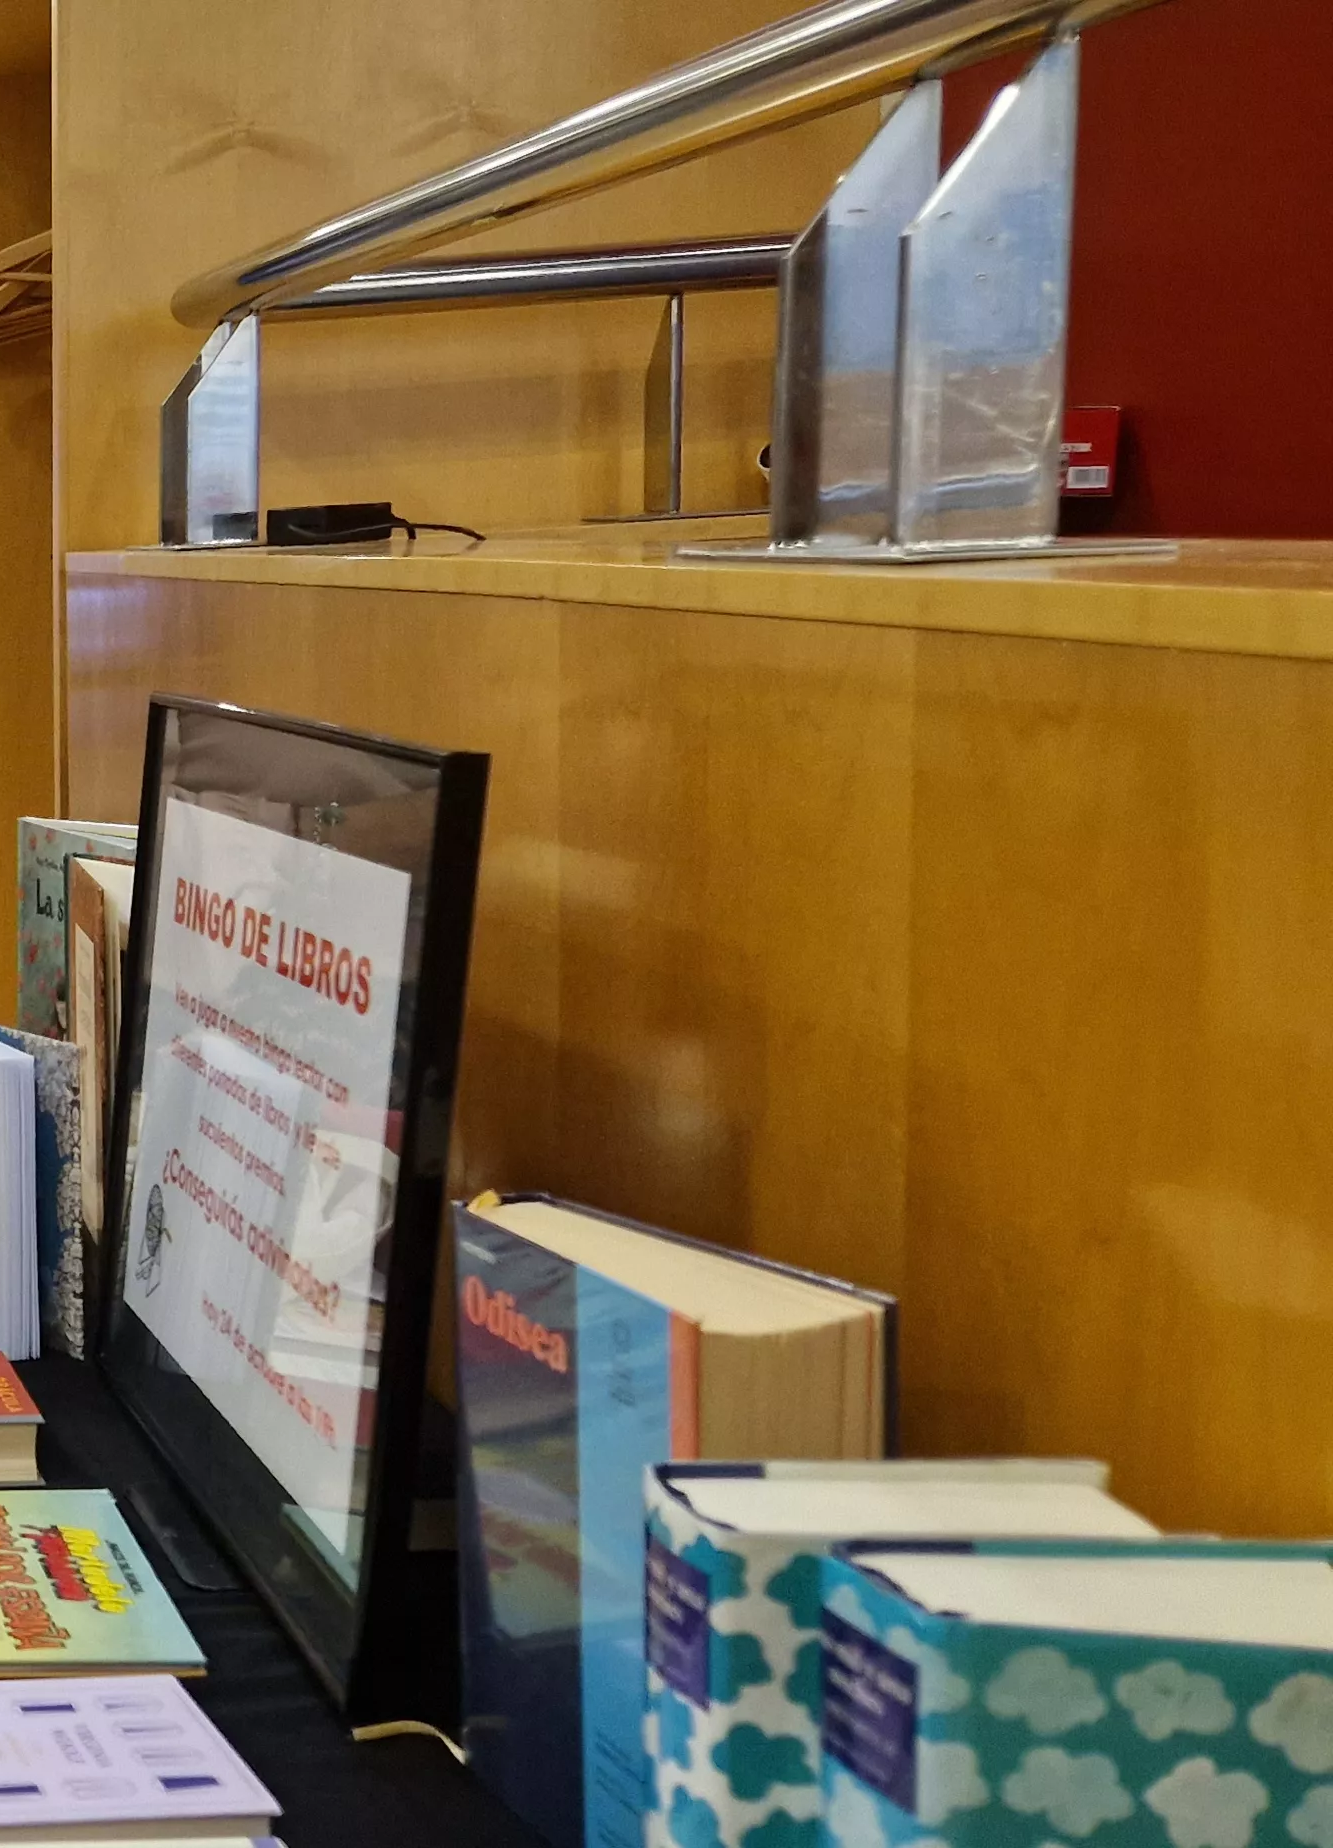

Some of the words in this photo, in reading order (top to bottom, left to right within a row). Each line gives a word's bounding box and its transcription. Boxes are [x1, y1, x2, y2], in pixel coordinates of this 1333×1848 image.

[35, 878, 53, 919] La
[174, 877, 236, 949] BINGO
[240, 906, 272, 967] DE
[276, 922, 372, 1015] LIBROS
[162, 1148, 244, 1242] ¿Conseguirás
[463, 1274, 568, 1374] Odisea
